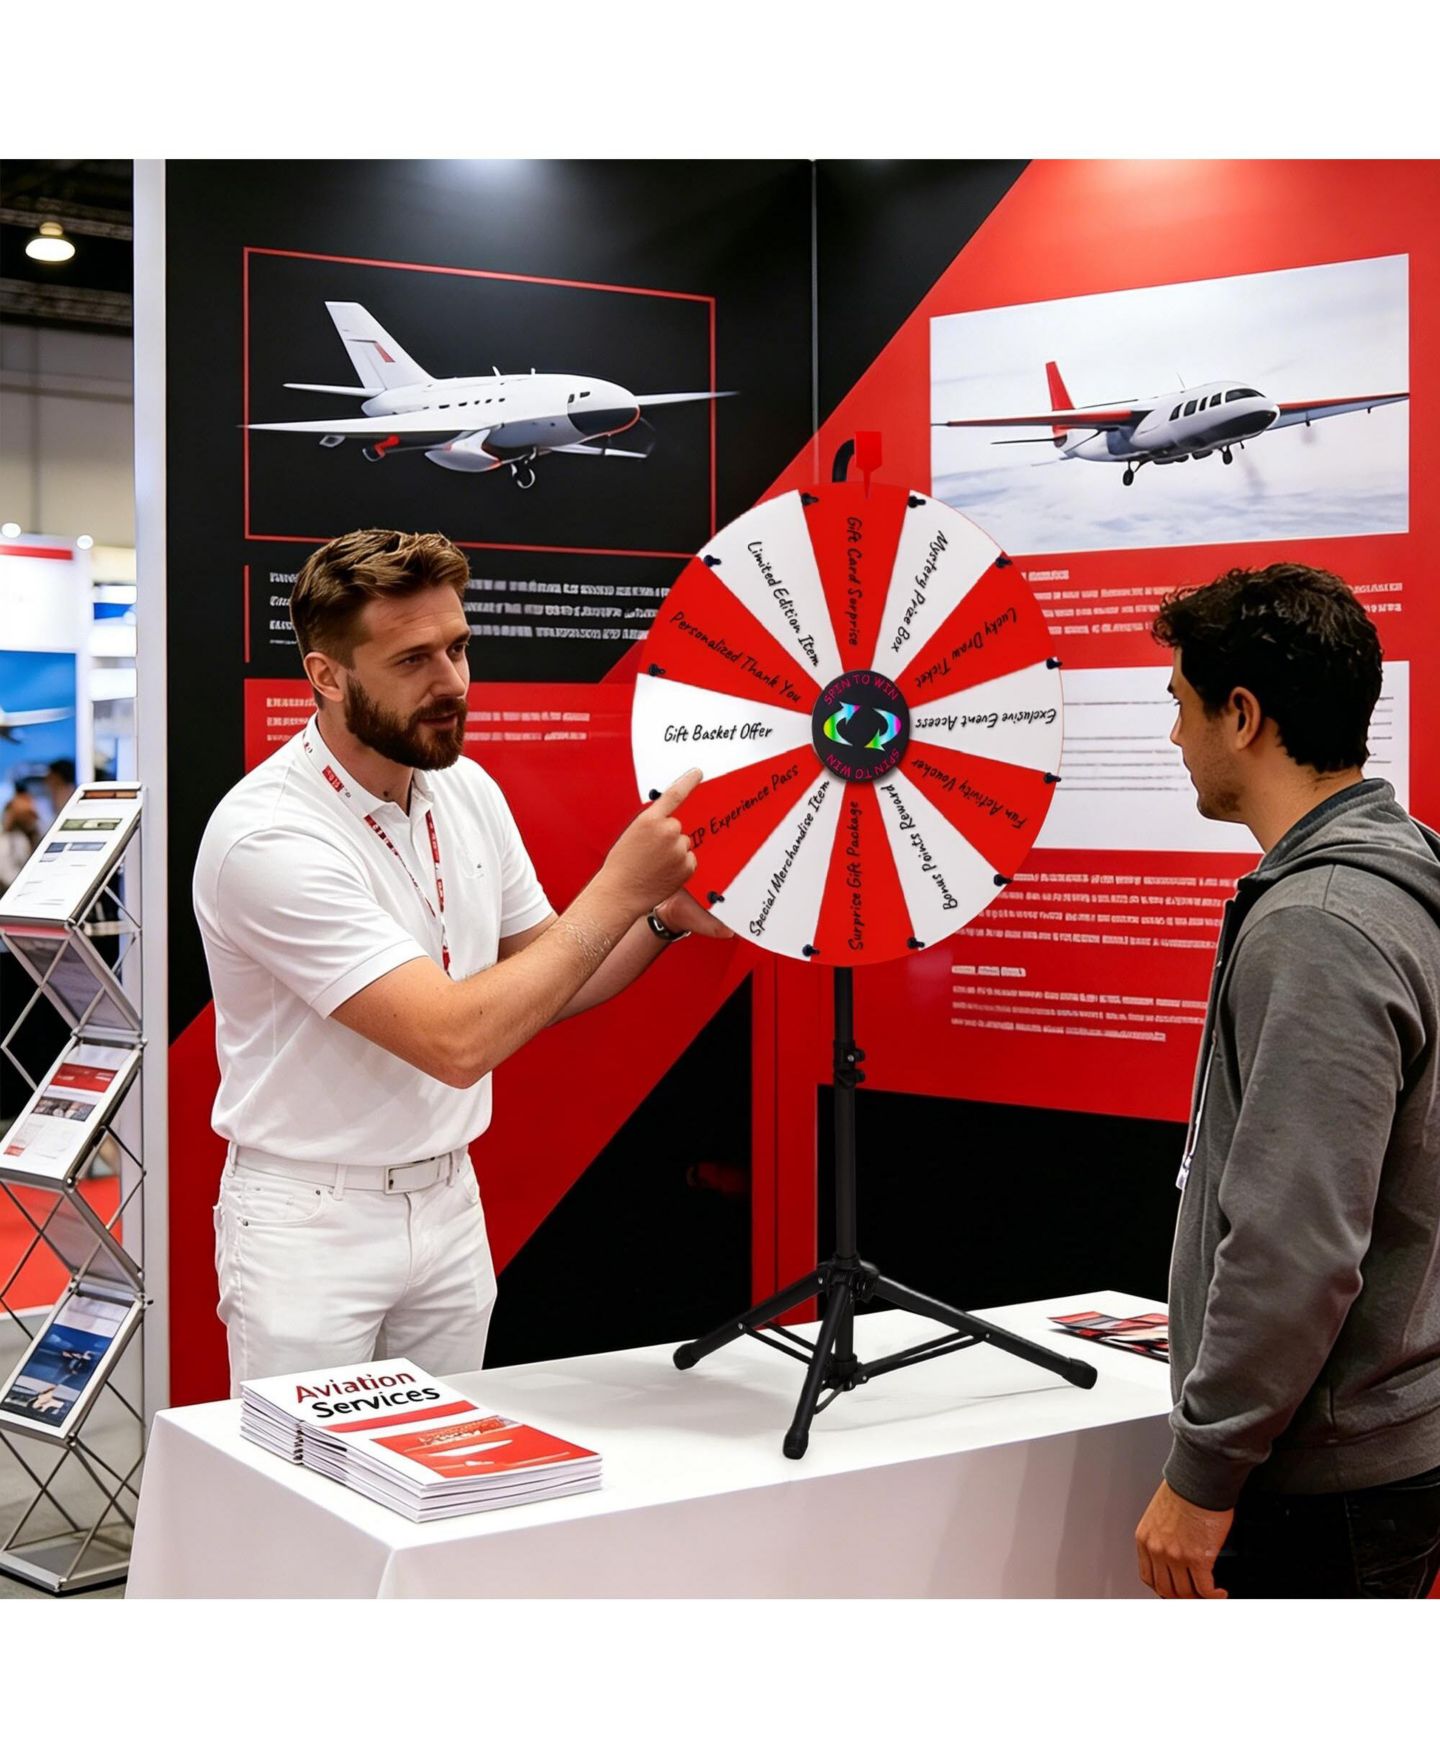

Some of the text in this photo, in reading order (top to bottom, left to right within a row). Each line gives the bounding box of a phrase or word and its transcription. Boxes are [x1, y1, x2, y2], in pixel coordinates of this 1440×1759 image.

[747, 541, 820, 667] Limited Edition Item
[845, 516, 863, 646] Gift Card Surprise
[891, 530, 948, 653] Mystery Prize Box
[951, 632, 983, 660] Draw
[985, 607, 1017, 634] Lucky
[670, 611, 743, 663] Personalized
[741, 655, 778, 688] Thank
[779, 679, 801, 702] You
[915, 662, 951, 688] Ticket
[824, 674, 899, 705] SPIN TO WIN
[664, 723, 773, 743] Gift Basket Offer
[915, 708, 1057, 731] Exclusive Event Access
[826, 748, 899, 779] SPIN TO WIN
[709, 785, 770, 835] Experience
[771, 764, 799, 791] Pass
[911, 758, 1027, 830] Fun Activity Voucher
[749, 780, 830, 937] Special Merchandise Item
[880, 784, 958, 910] Bonus Points Reward
[847, 801, 865, 950] Surprise Gift Package
[295, 1370, 416, 1403] Aviation
[311, 1385, 441, 1418] Services
